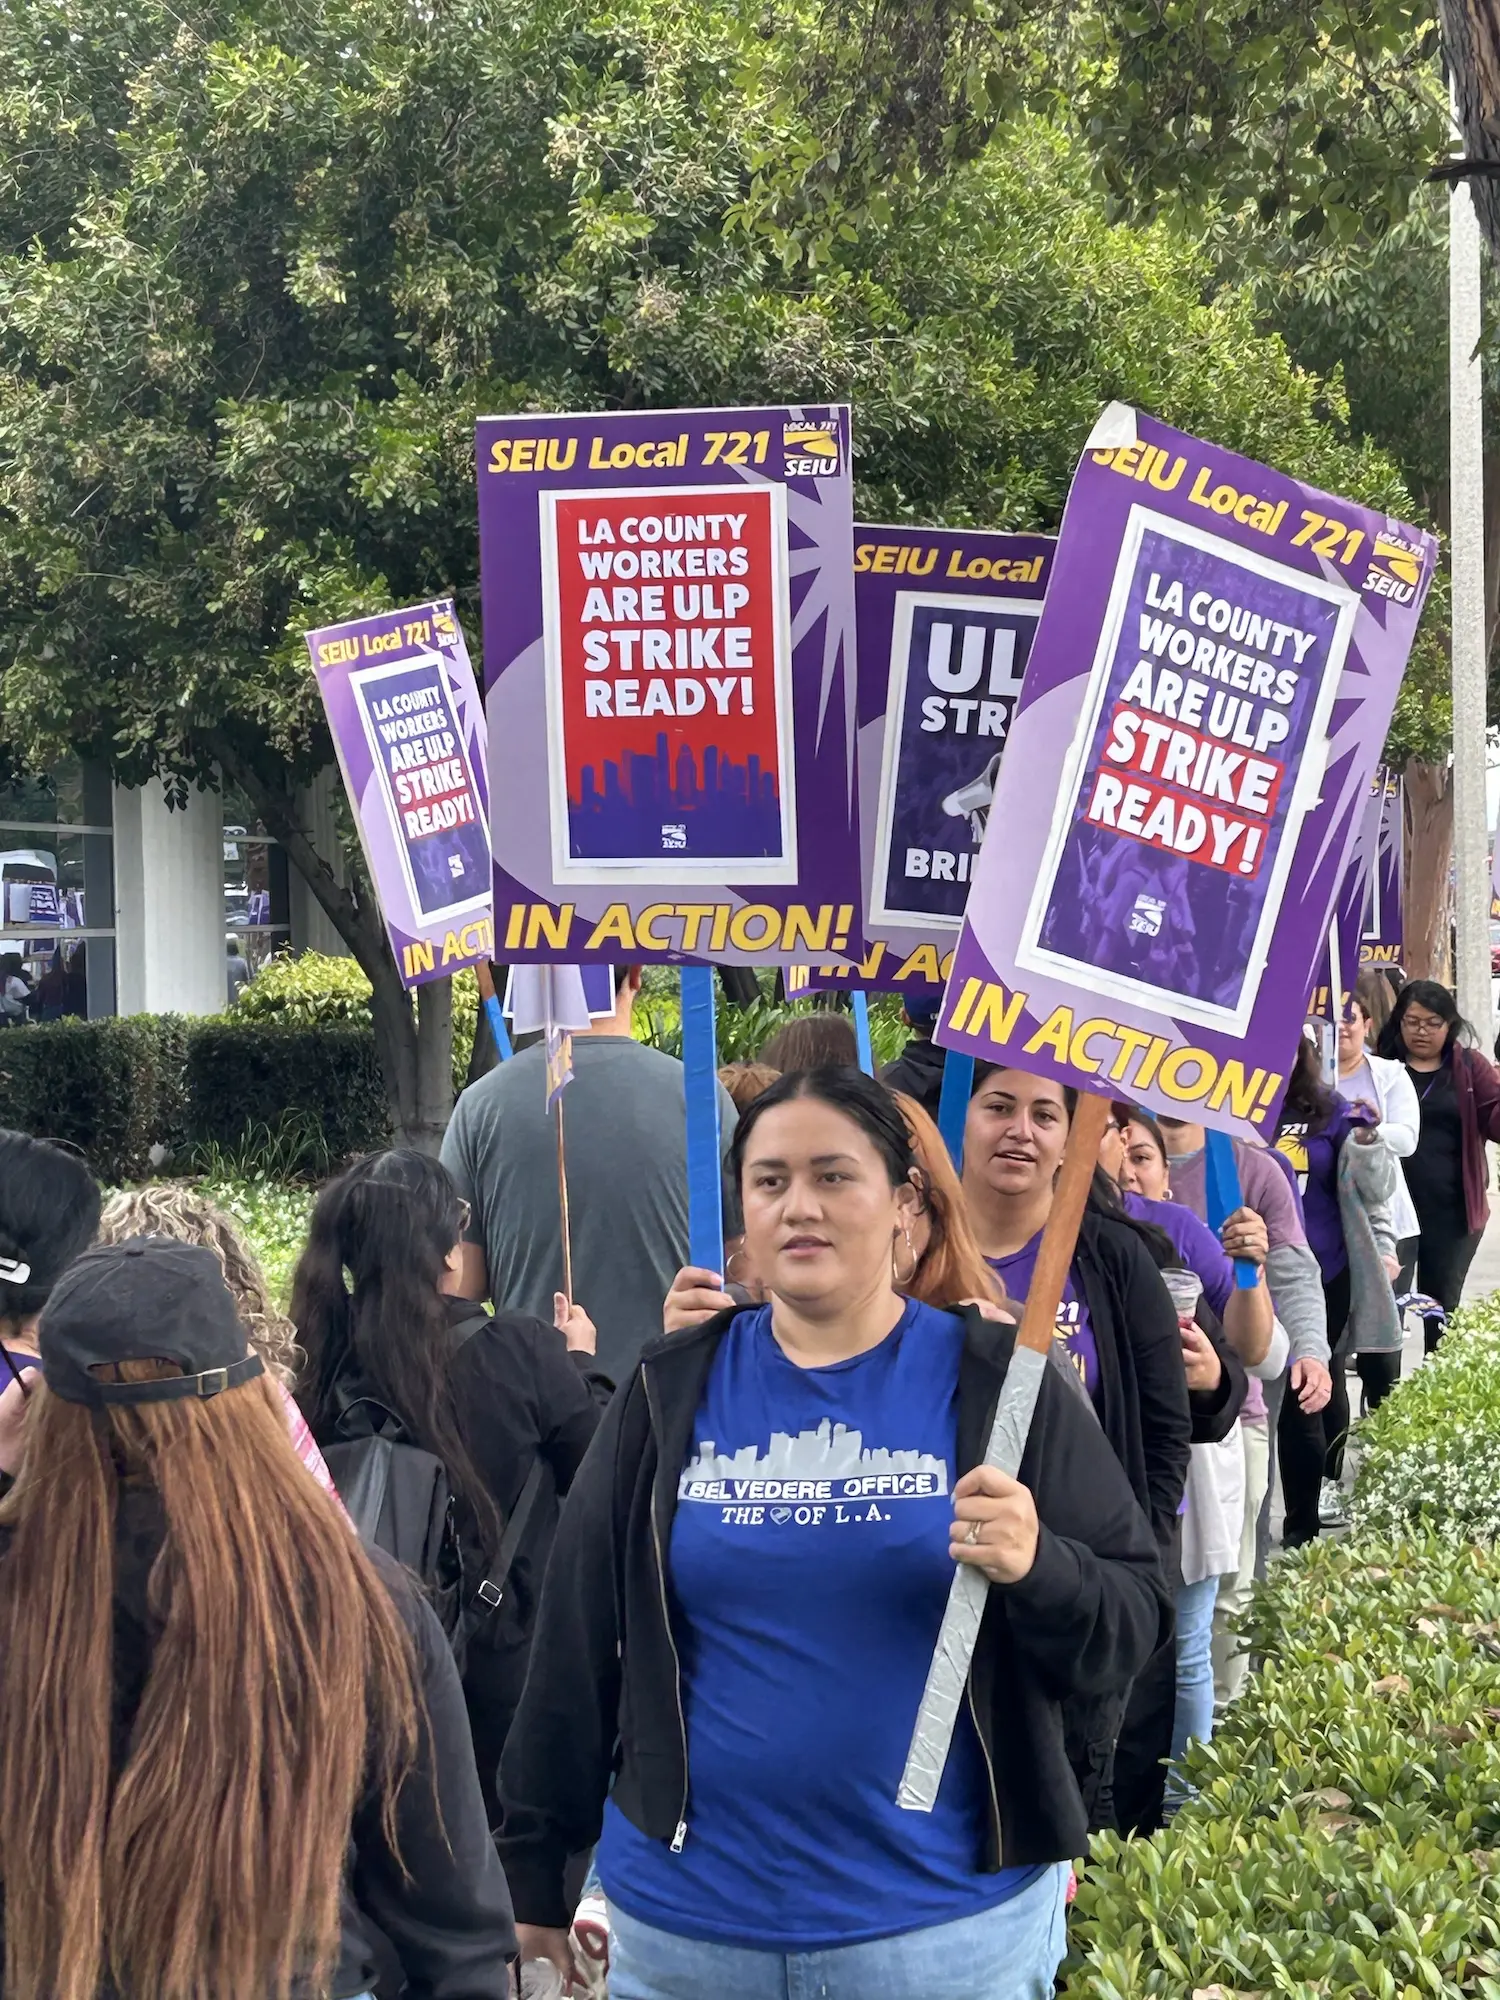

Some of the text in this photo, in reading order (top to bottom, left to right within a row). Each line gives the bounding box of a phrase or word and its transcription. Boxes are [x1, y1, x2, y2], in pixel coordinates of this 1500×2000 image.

[488, 431, 770, 473] SEIU Local 721
[784, 458, 838, 477] SEIU
[577, 513, 748, 545] LA COUNTY
[1187, 466, 1290, 536] Local
[1290, 510, 1366, 565] 721
[578, 547, 749, 580] WORKERS
[853, 544, 1045, 583] SEIU Local
[580, 583, 750, 623] ARE ULP
[1361, 572, 1415, 603] SEIU
[1144, 572, 1317, 664] LA COUNTY
[317, 636, 360, 668] SEIU
[362, 626, 403, 656] Local
[403, 615, 431, 646] 721
[582, 626, 753, 673] STRIKE
[1138, 613, 1300, 706] WORKERS
[372, 686, 442, 721] LA COUNTY
[584, 676, 754, 718] READY!
[920, 695, 1016, 738] STR
[1119, 659, 1290, 753] ARE ULP
[379, 708, 448, 745] WORKERS
[390, 732, 456, 774] ARE ULP
[1105, 710, 1278, 815] STRIKE
[395, 758, 467, 805] STRIKE
[403, 792, 475, 840] READY!
[1088, 772, 1263, 875] READY!
[905, 847, 980, 883] BRI
[504, 903, 854, 951] IN ACTION!
[402, 938, 435, 979] IN
[948, 976, 1284, 1124] IN ACTION!
[1280, 1122, 1309, 1136] 721
[688, 1474, 933, 1500] BELVEDERE OFFICE
[721, 1506, 765, 1525] THE
[794, 1506, 827, 1526] OF
